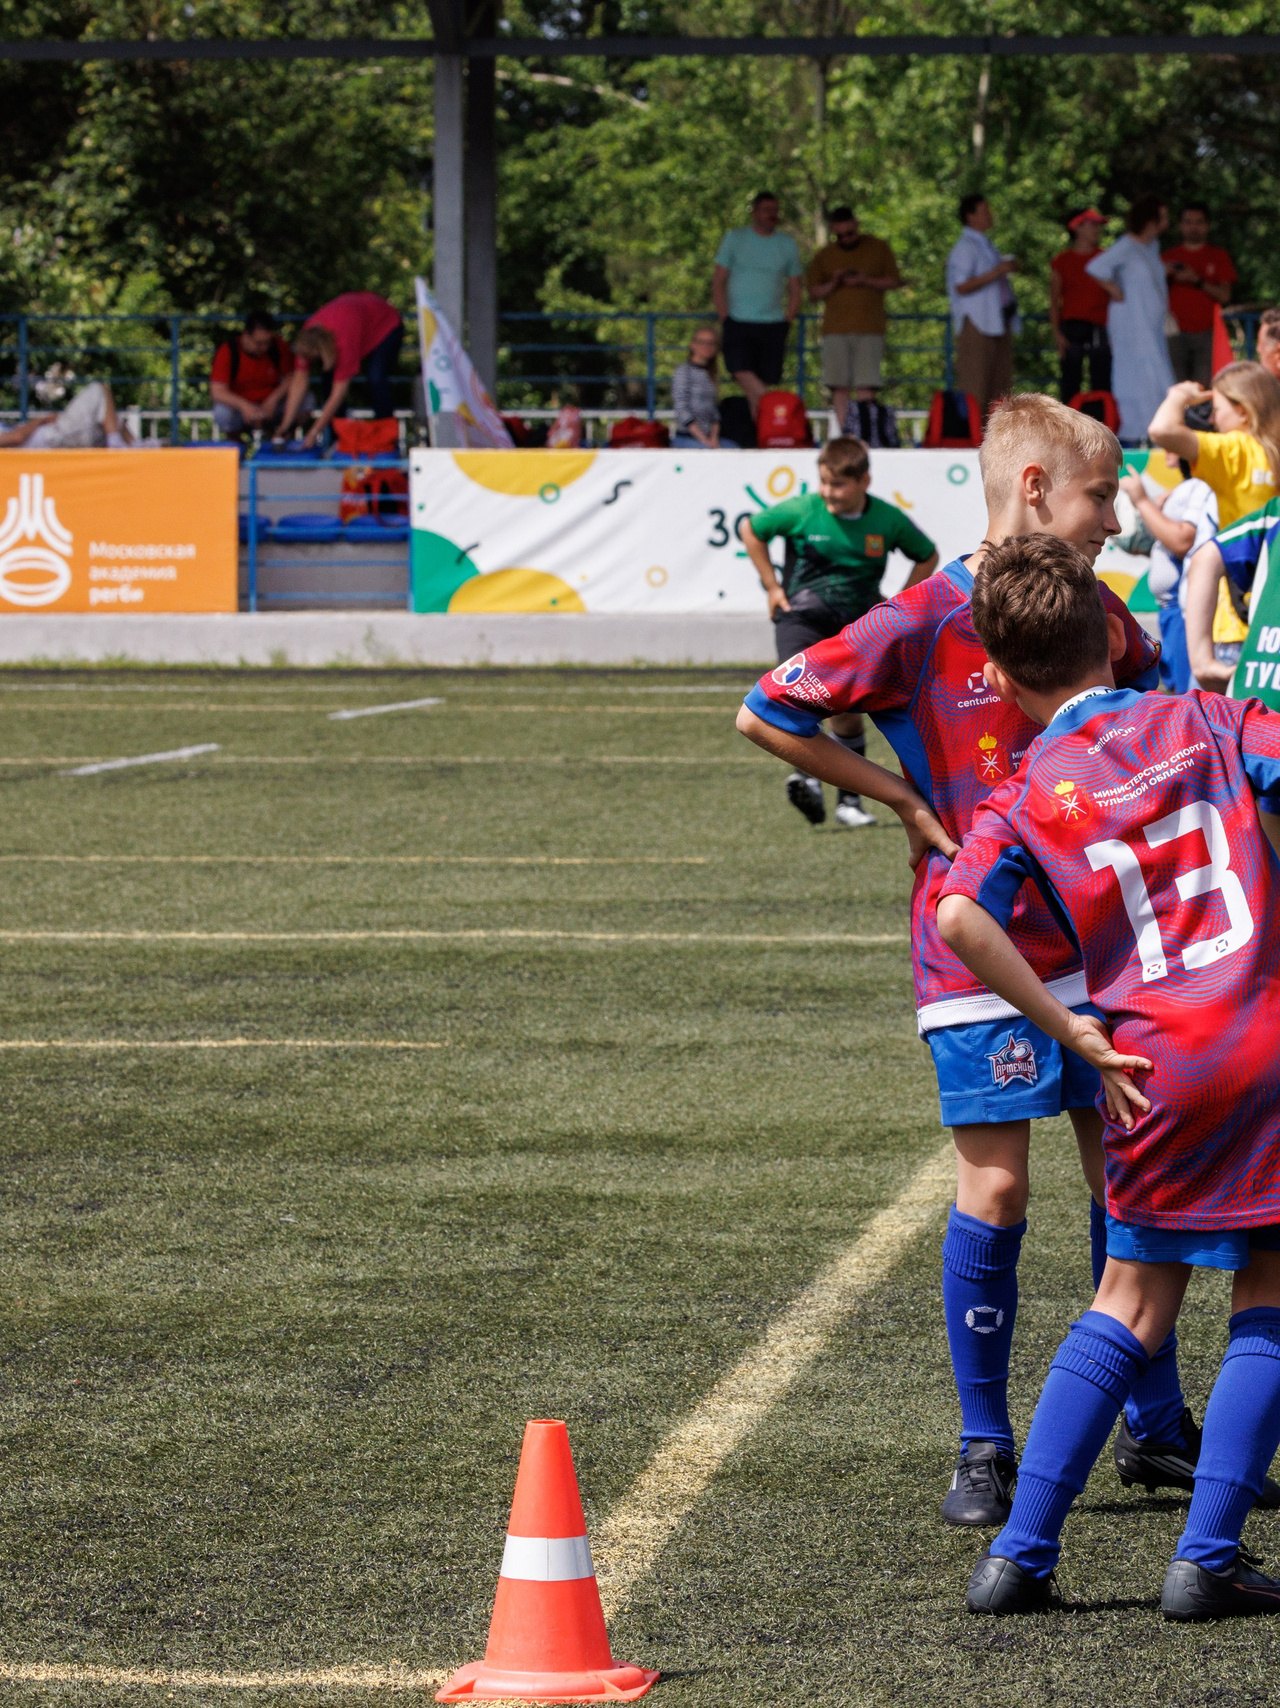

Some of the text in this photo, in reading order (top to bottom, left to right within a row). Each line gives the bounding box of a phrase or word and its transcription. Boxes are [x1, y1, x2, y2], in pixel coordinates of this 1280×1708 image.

[89, 583, 144, 605] регби
[807, 671, 831, 699] ЦЕНТР
[1087, 726, 1136, 755] centurion
[1093, 741, 1208, 799] МИНИСТЕРСТВО СПОРТА
[1096, 758, 1195, 807] ТУЛЬСКОЙ ОБЛАСТИ
[1084, 800, 1254, 983] 13
